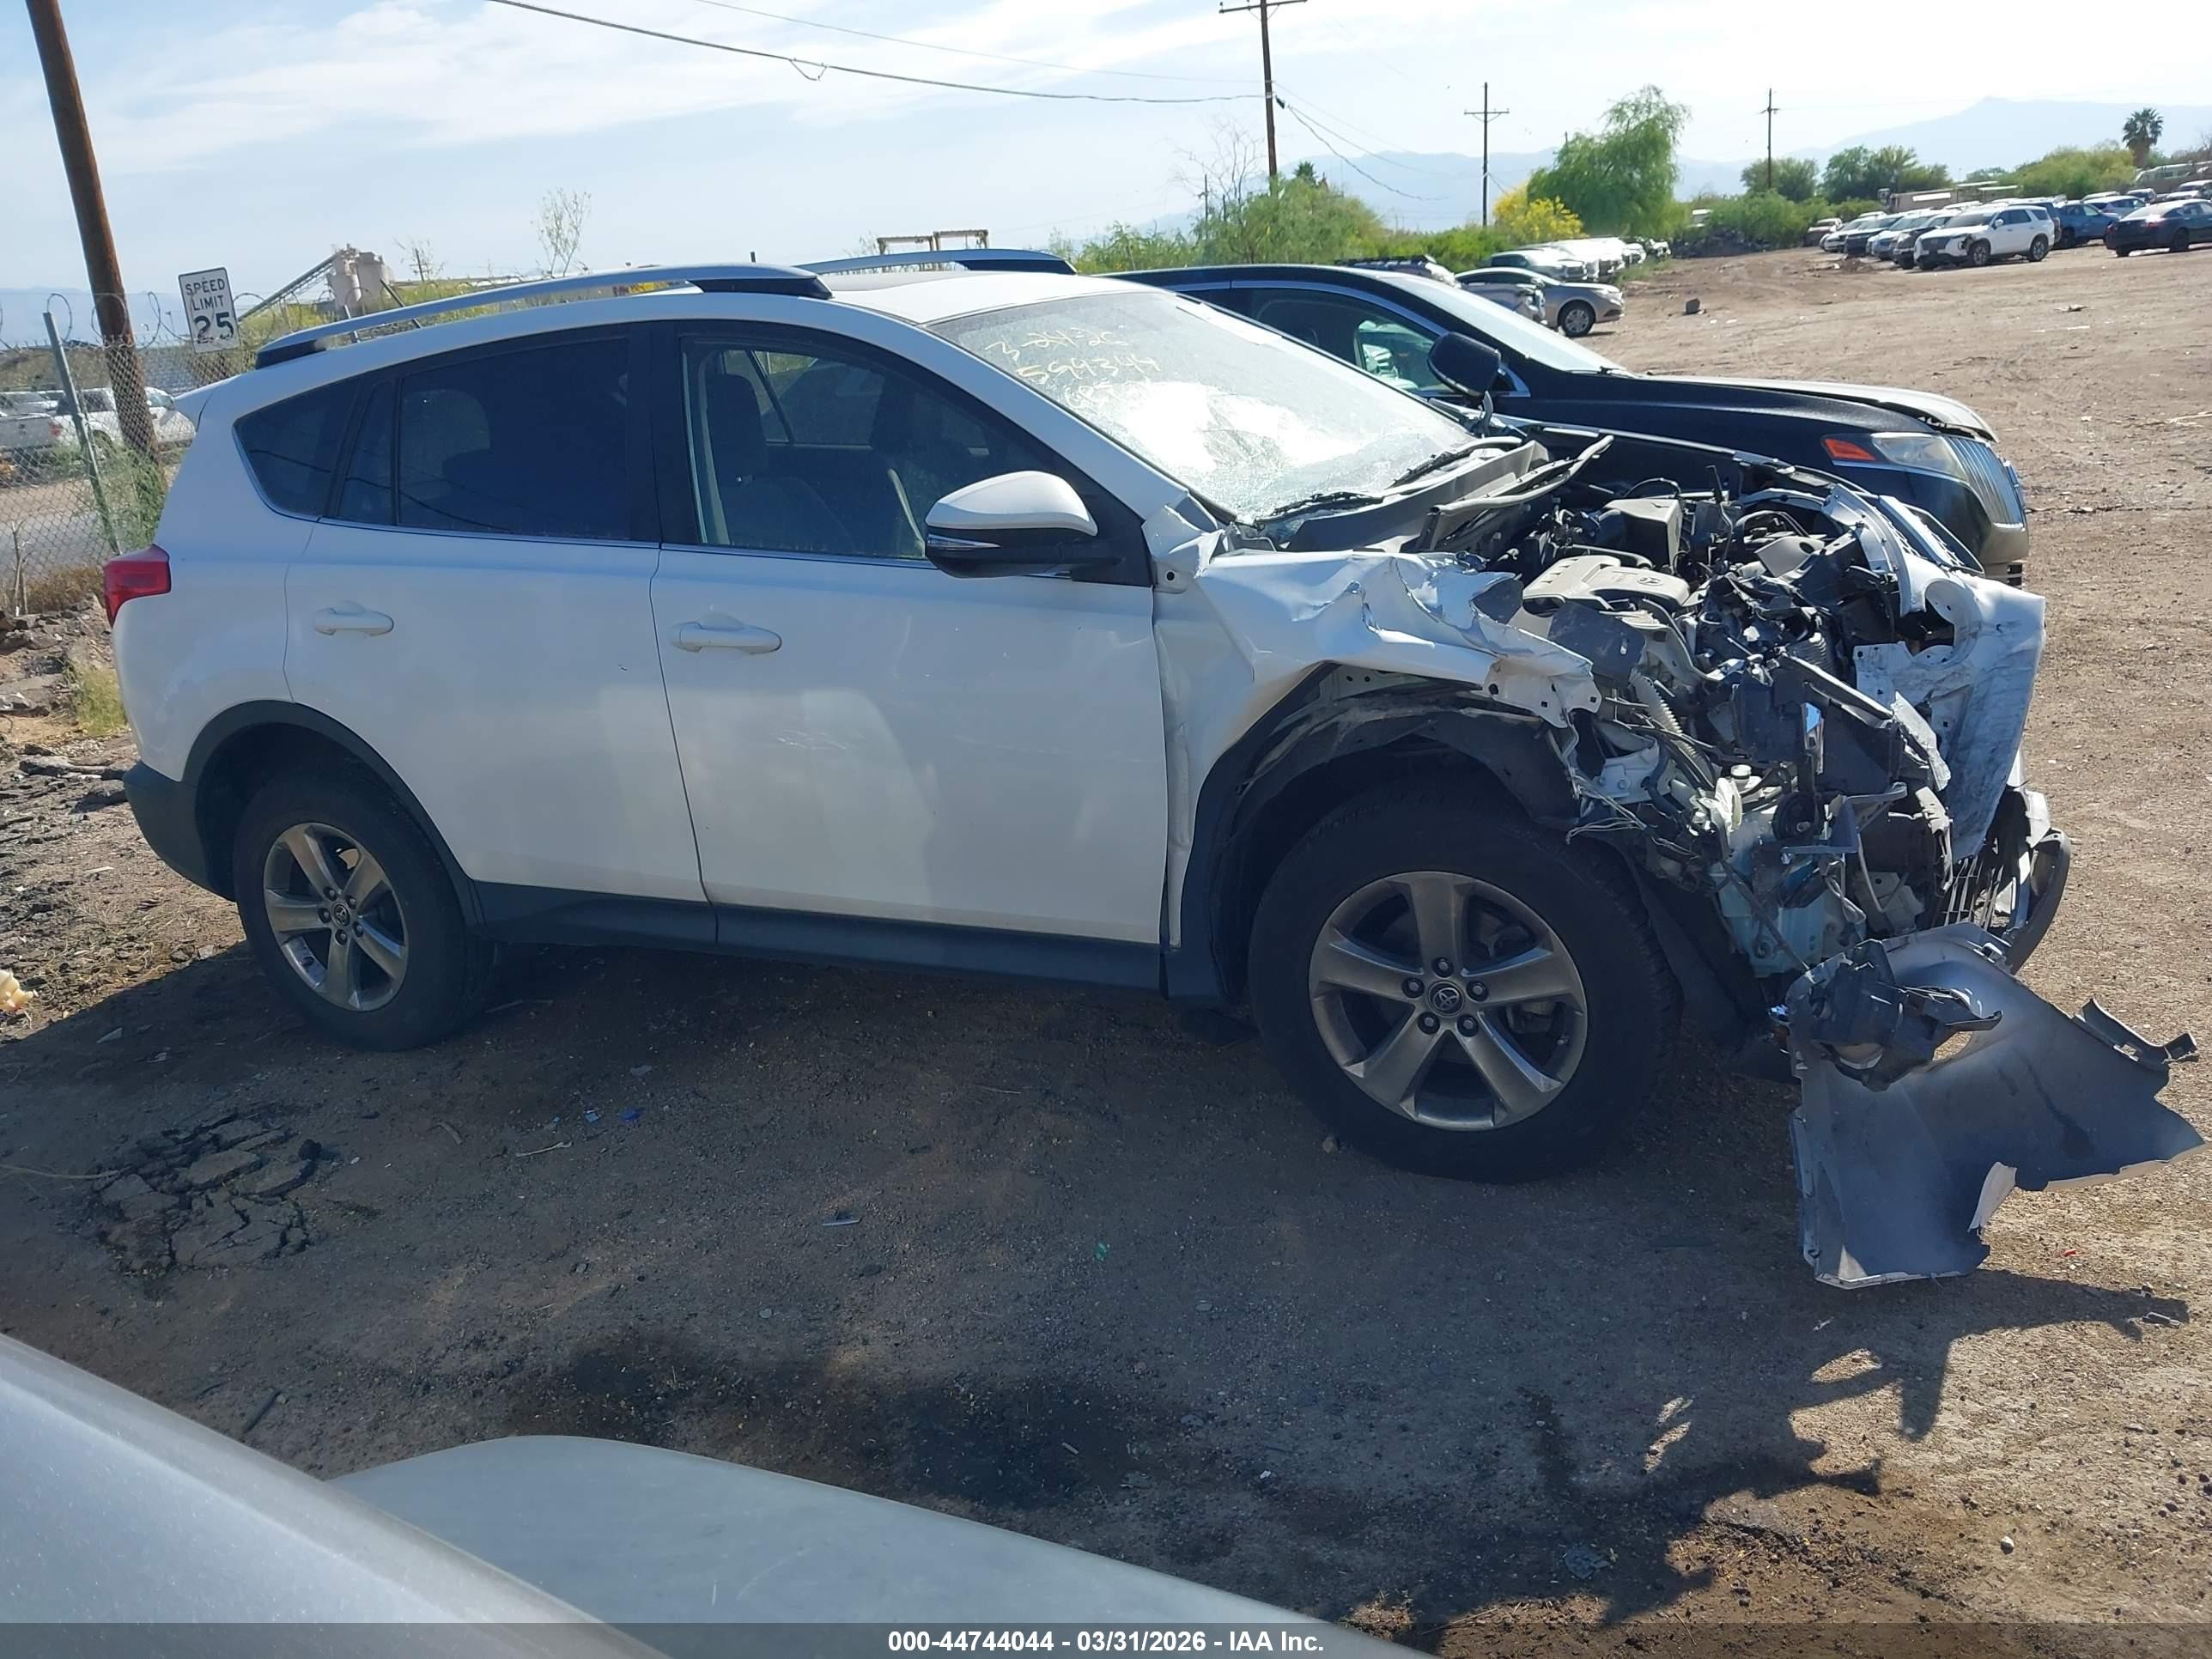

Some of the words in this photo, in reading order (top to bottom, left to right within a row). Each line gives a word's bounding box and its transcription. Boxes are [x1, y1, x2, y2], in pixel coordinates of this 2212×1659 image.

[185, 278, 225, 295] SPEED
[191, 295, 224, 311] LIMIT
[193, 312, 234, 343] 25
